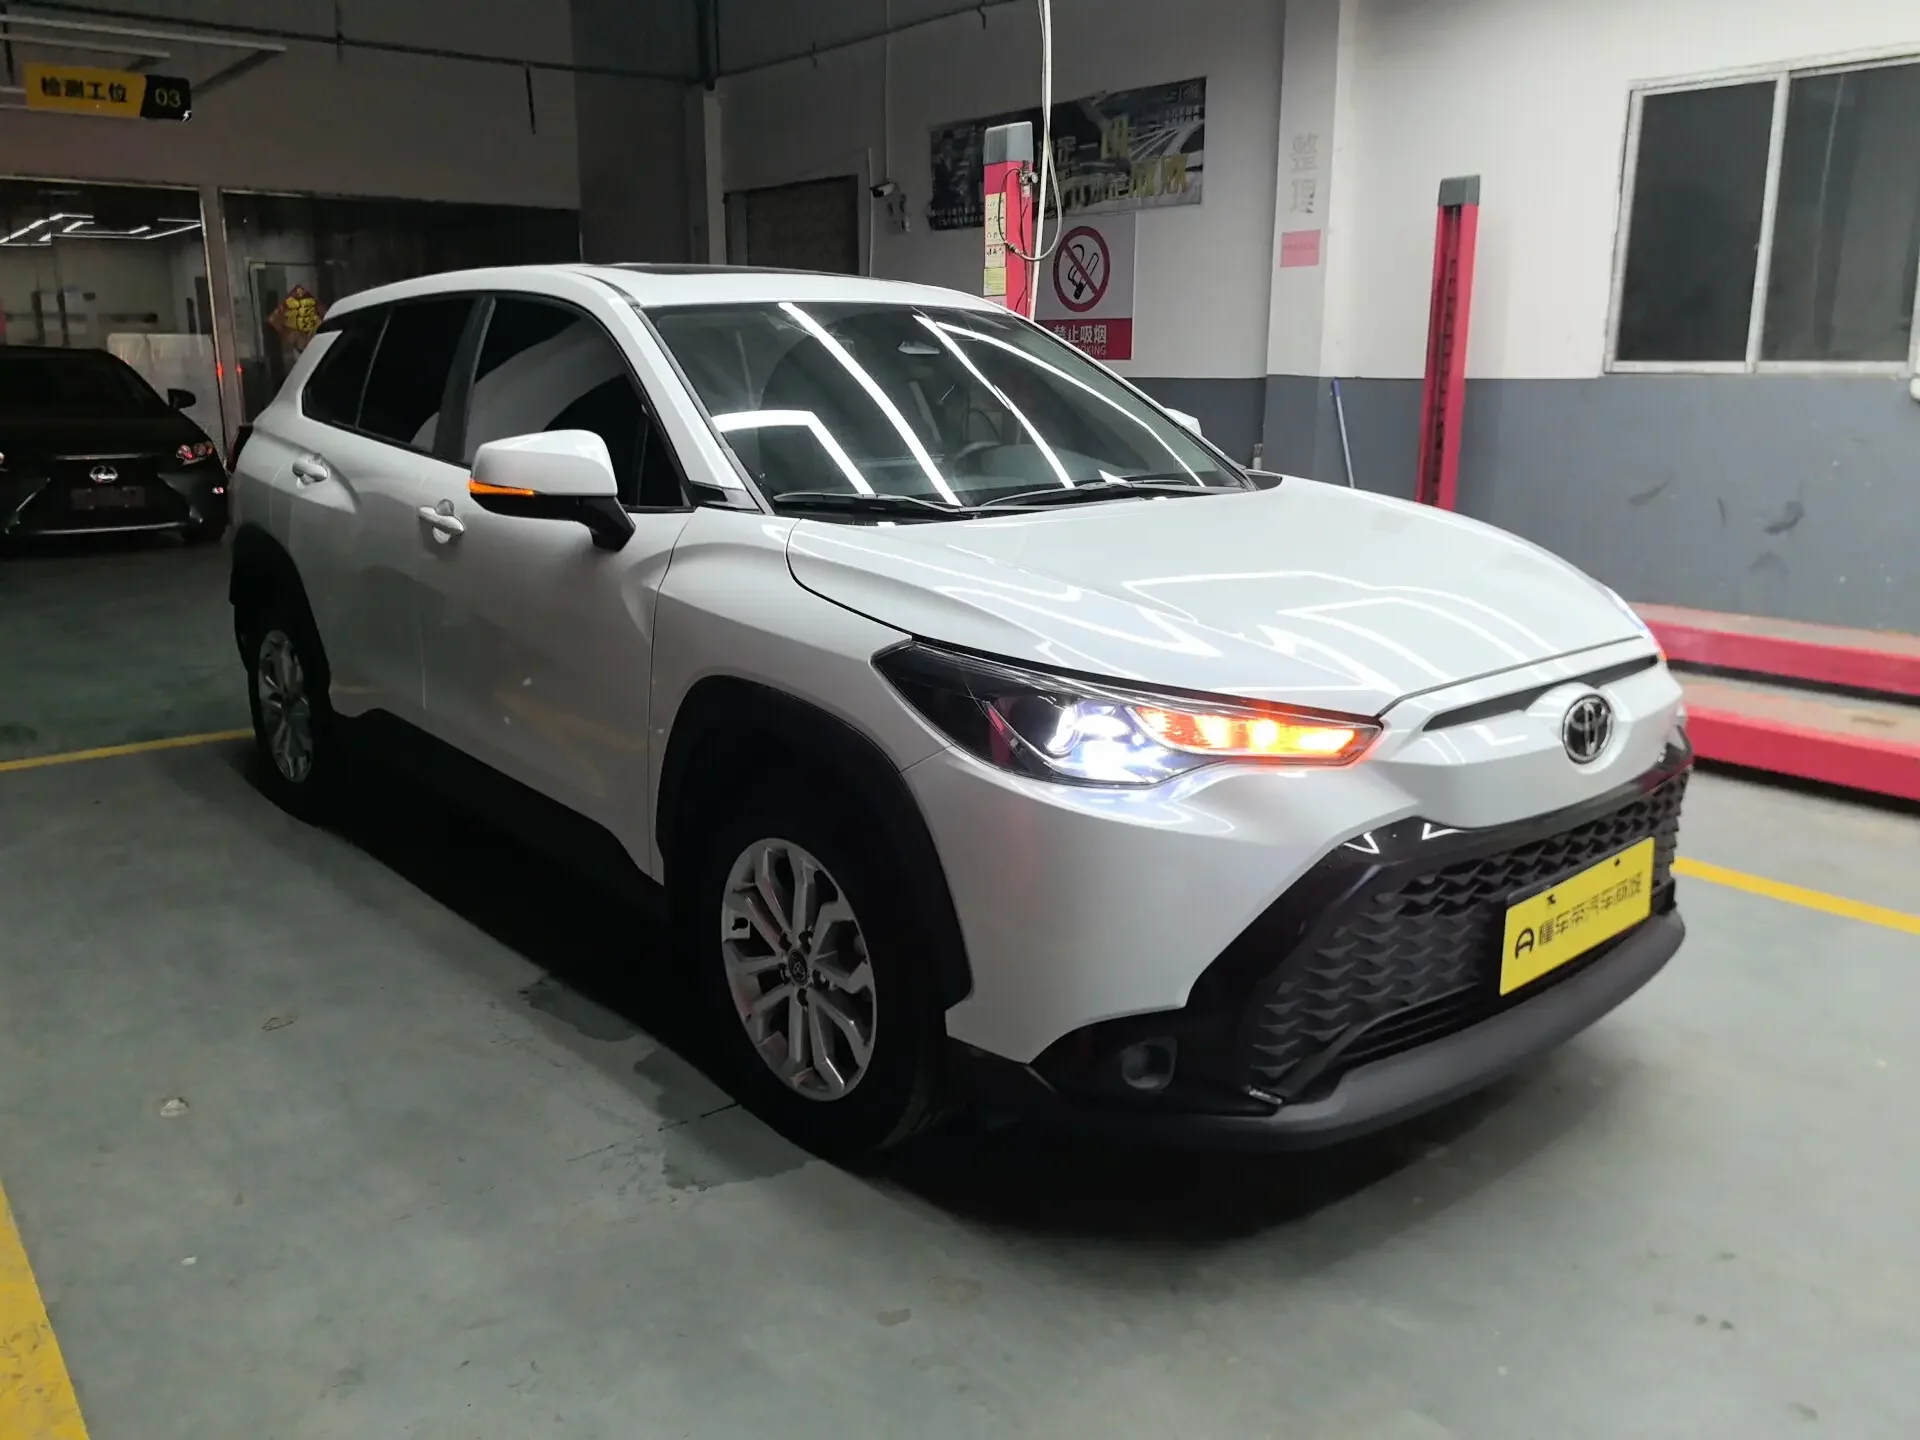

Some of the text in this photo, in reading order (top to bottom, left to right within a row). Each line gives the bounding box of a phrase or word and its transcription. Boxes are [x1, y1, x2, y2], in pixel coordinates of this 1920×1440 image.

[155, 88, 182, 108] 03
[1054, 324, 1107, 344] 禁止吸烟
